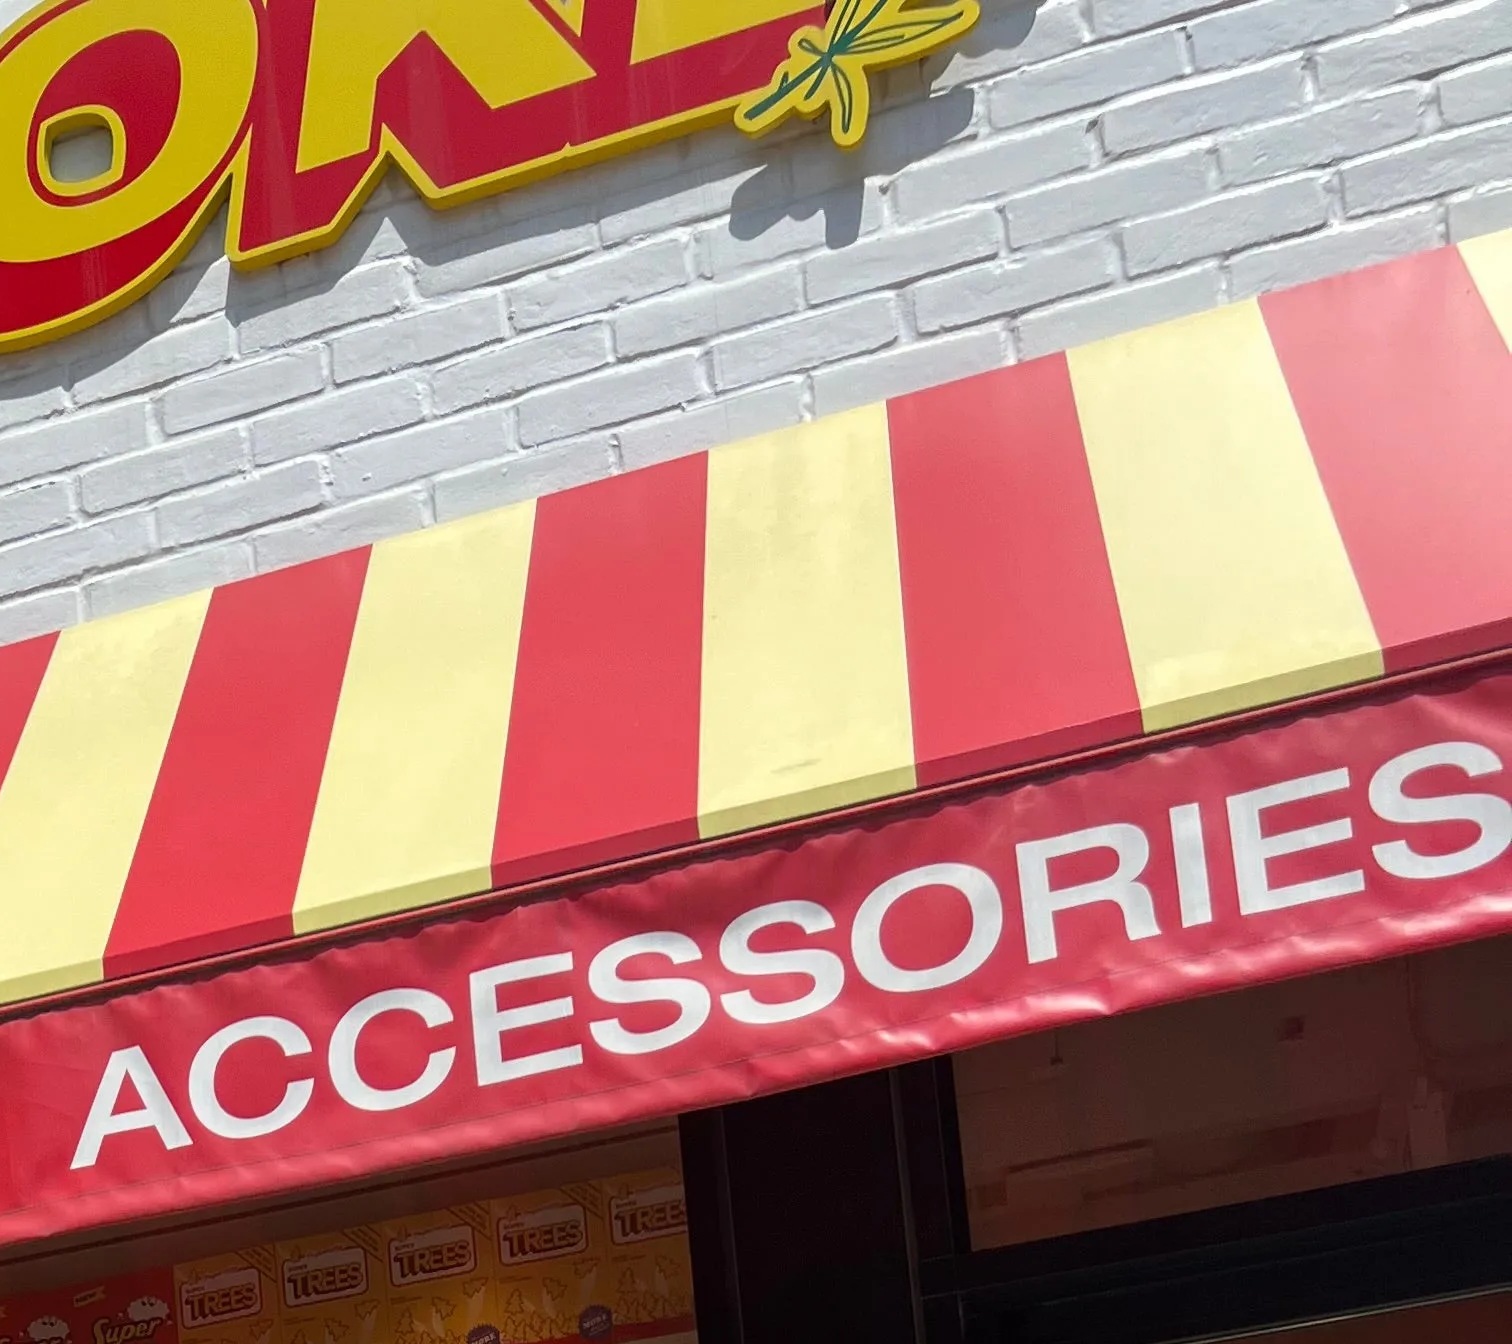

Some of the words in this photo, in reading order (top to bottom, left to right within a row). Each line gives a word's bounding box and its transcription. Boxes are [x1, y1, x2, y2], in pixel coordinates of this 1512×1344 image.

[69, 740, 1512, 1171] ACCESSORIES
[503, 1219, 583, 1256] TREES
[394, 1241, 471, 1277] TREES
[288, 1262, 363, 1295] TREES
